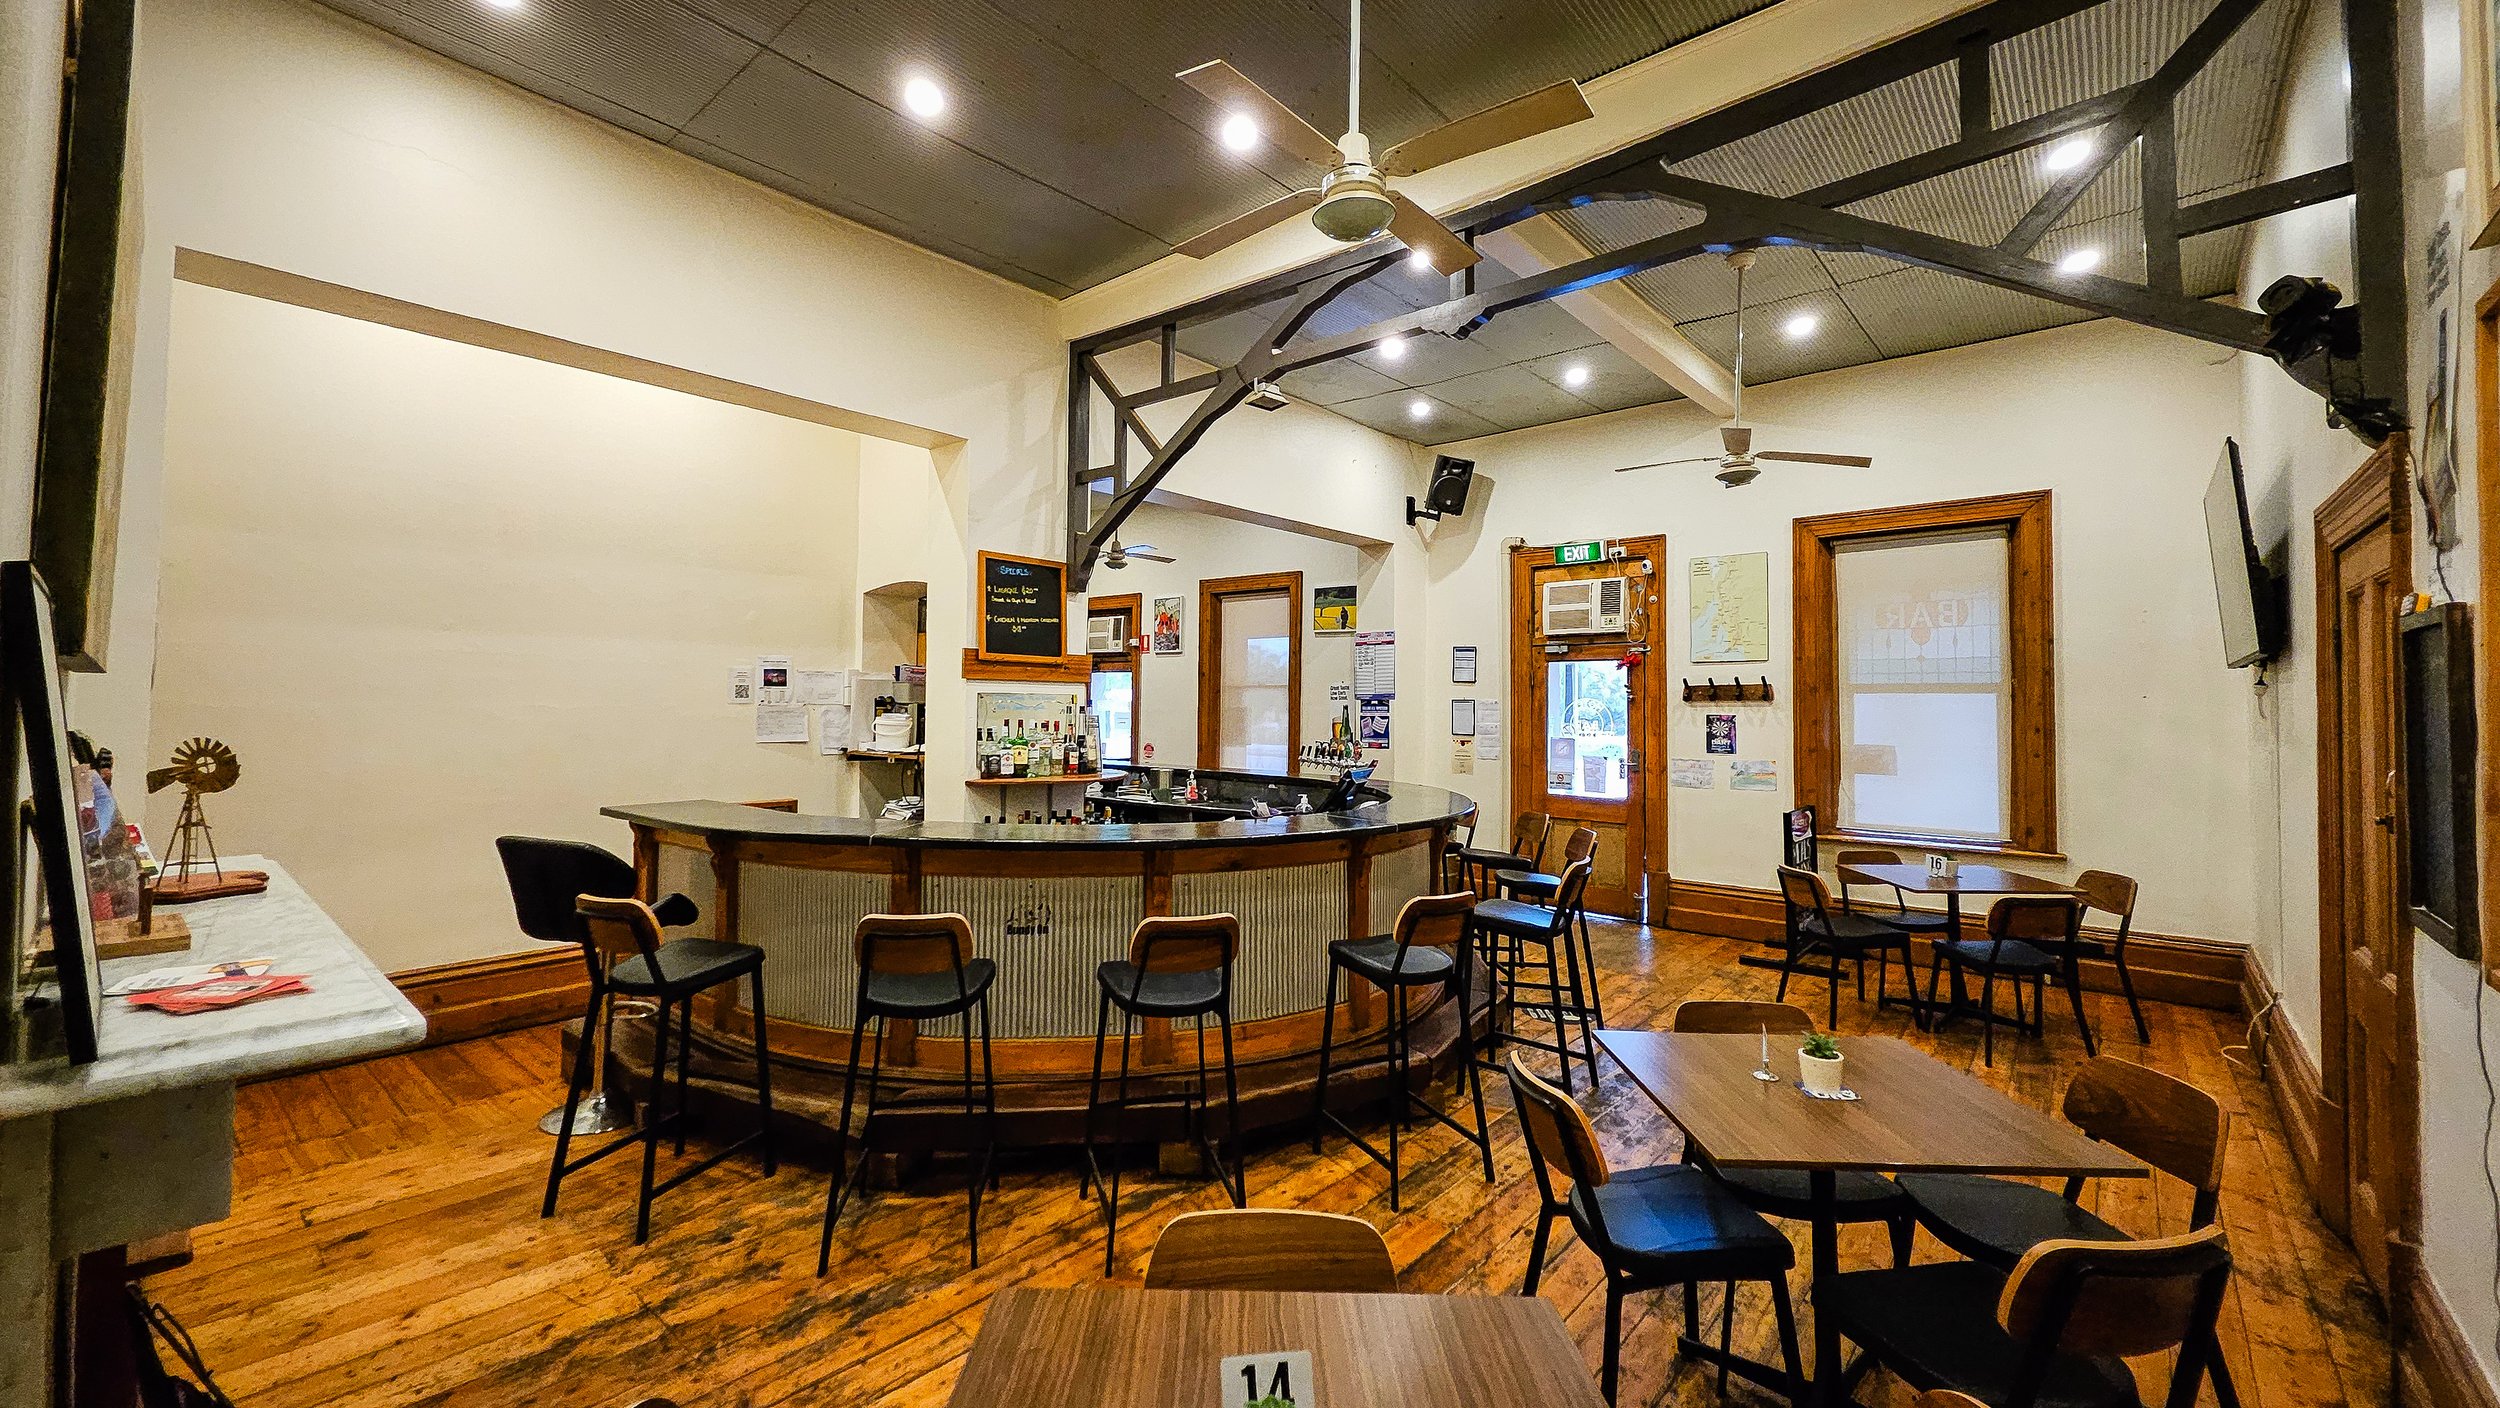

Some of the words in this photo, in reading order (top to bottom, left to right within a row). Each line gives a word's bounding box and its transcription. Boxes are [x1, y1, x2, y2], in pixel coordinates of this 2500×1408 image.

[1564, 545, 1590, 561] EXIT
[1930, 856, 1942, 870] 16
[1241, 1361, 1295, 1406] 14
